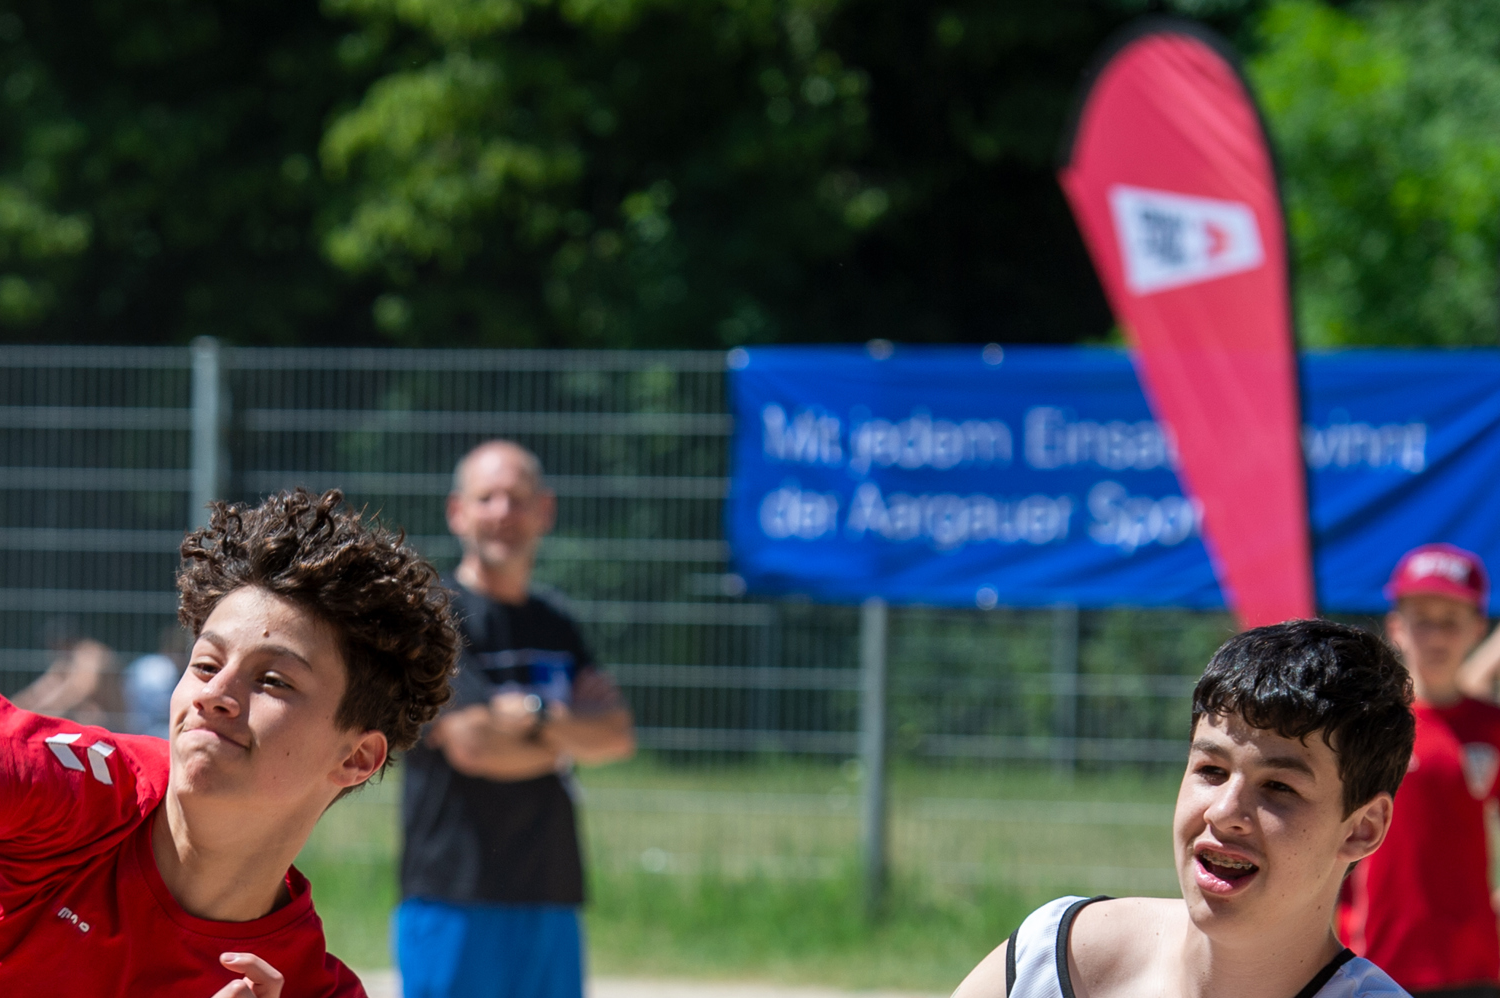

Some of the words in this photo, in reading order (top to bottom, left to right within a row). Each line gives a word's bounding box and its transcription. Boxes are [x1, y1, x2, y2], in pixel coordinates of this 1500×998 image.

[850, 406, 1013, 477] jedem
[1025, 406, 1177, 468] Einsa
[760, 484, 838, 539] der
[846, 480, 1072, 550] Aargauer
[1088, 482, 1204, 553] Spo
